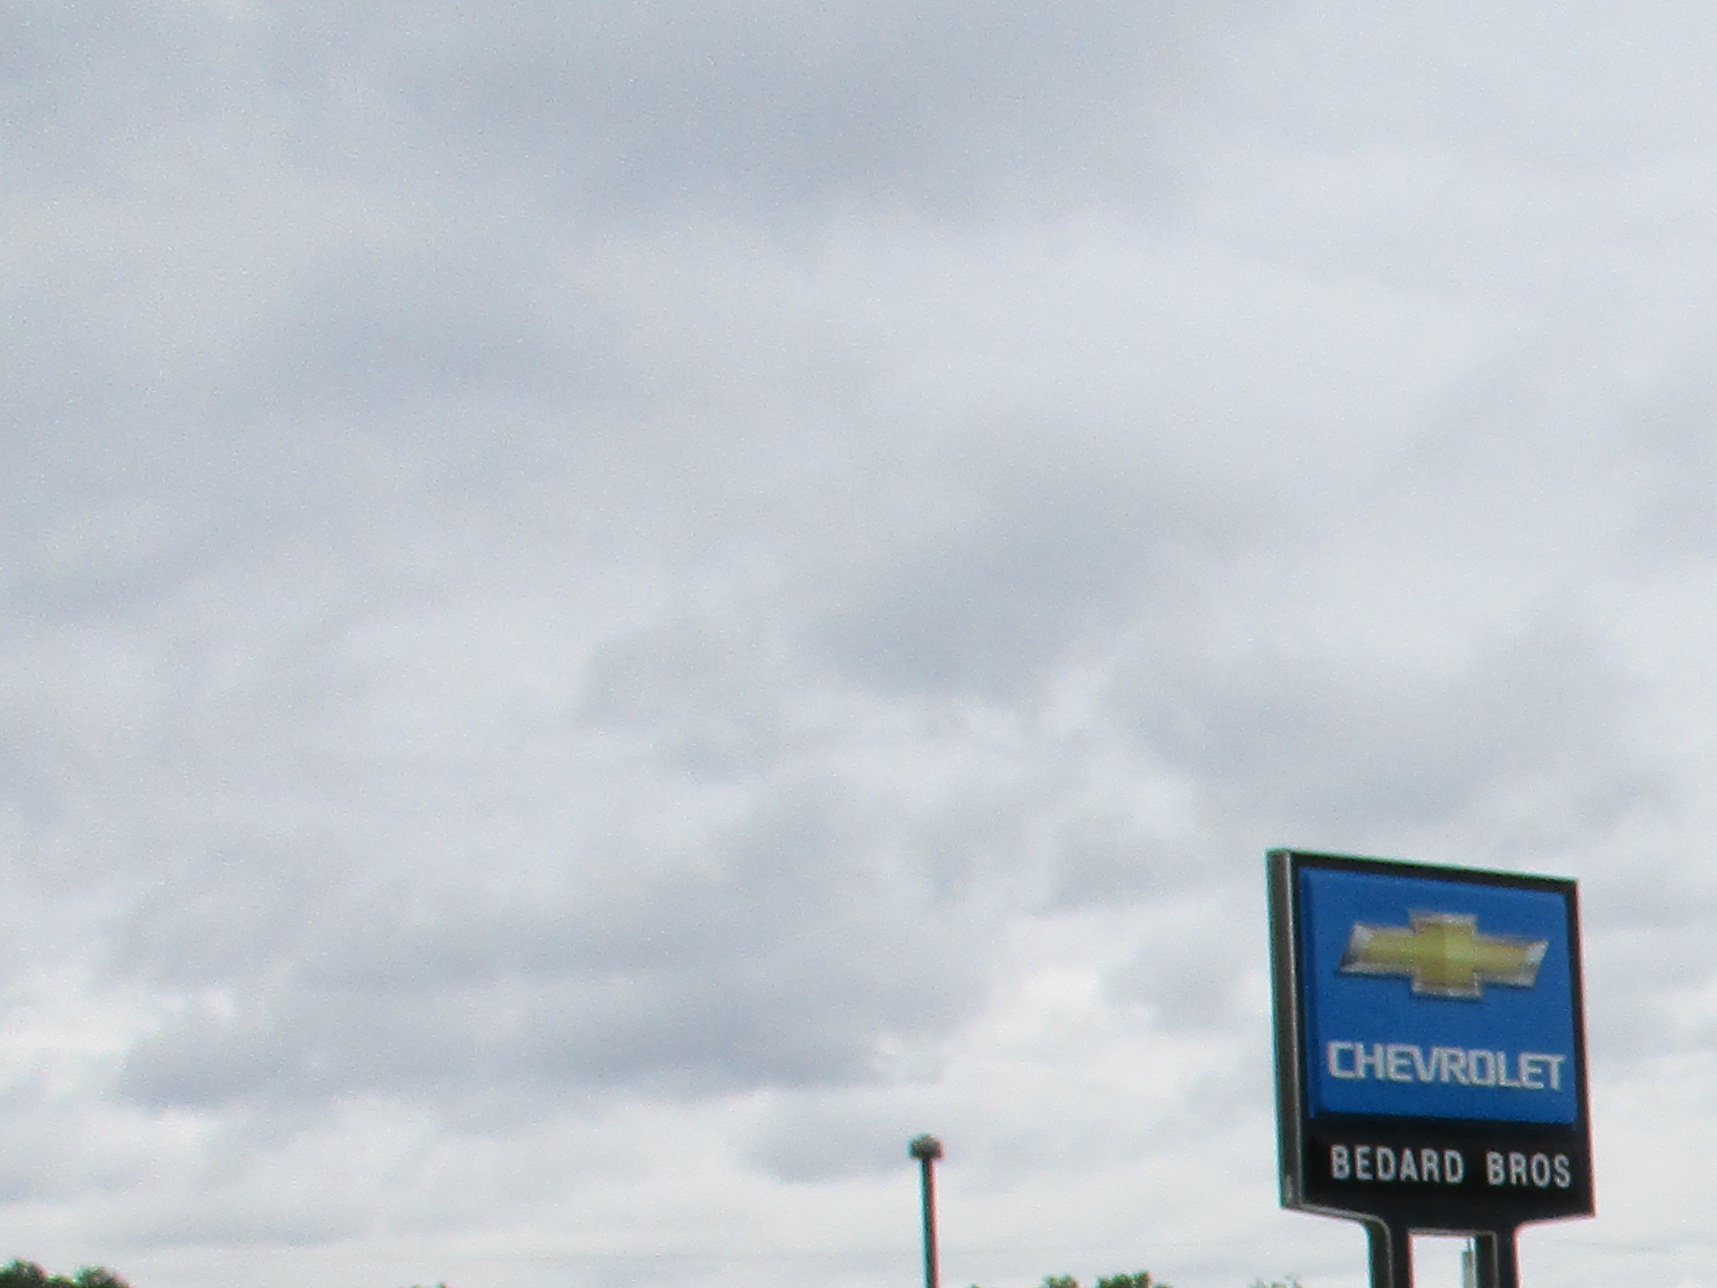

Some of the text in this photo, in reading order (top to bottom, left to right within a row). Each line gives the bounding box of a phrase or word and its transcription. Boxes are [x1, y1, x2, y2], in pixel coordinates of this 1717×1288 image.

[1327, 1041, 1566, 1090] CHEVROLET
[1330, 1144, 1571, 1188] BEDARD BROS
